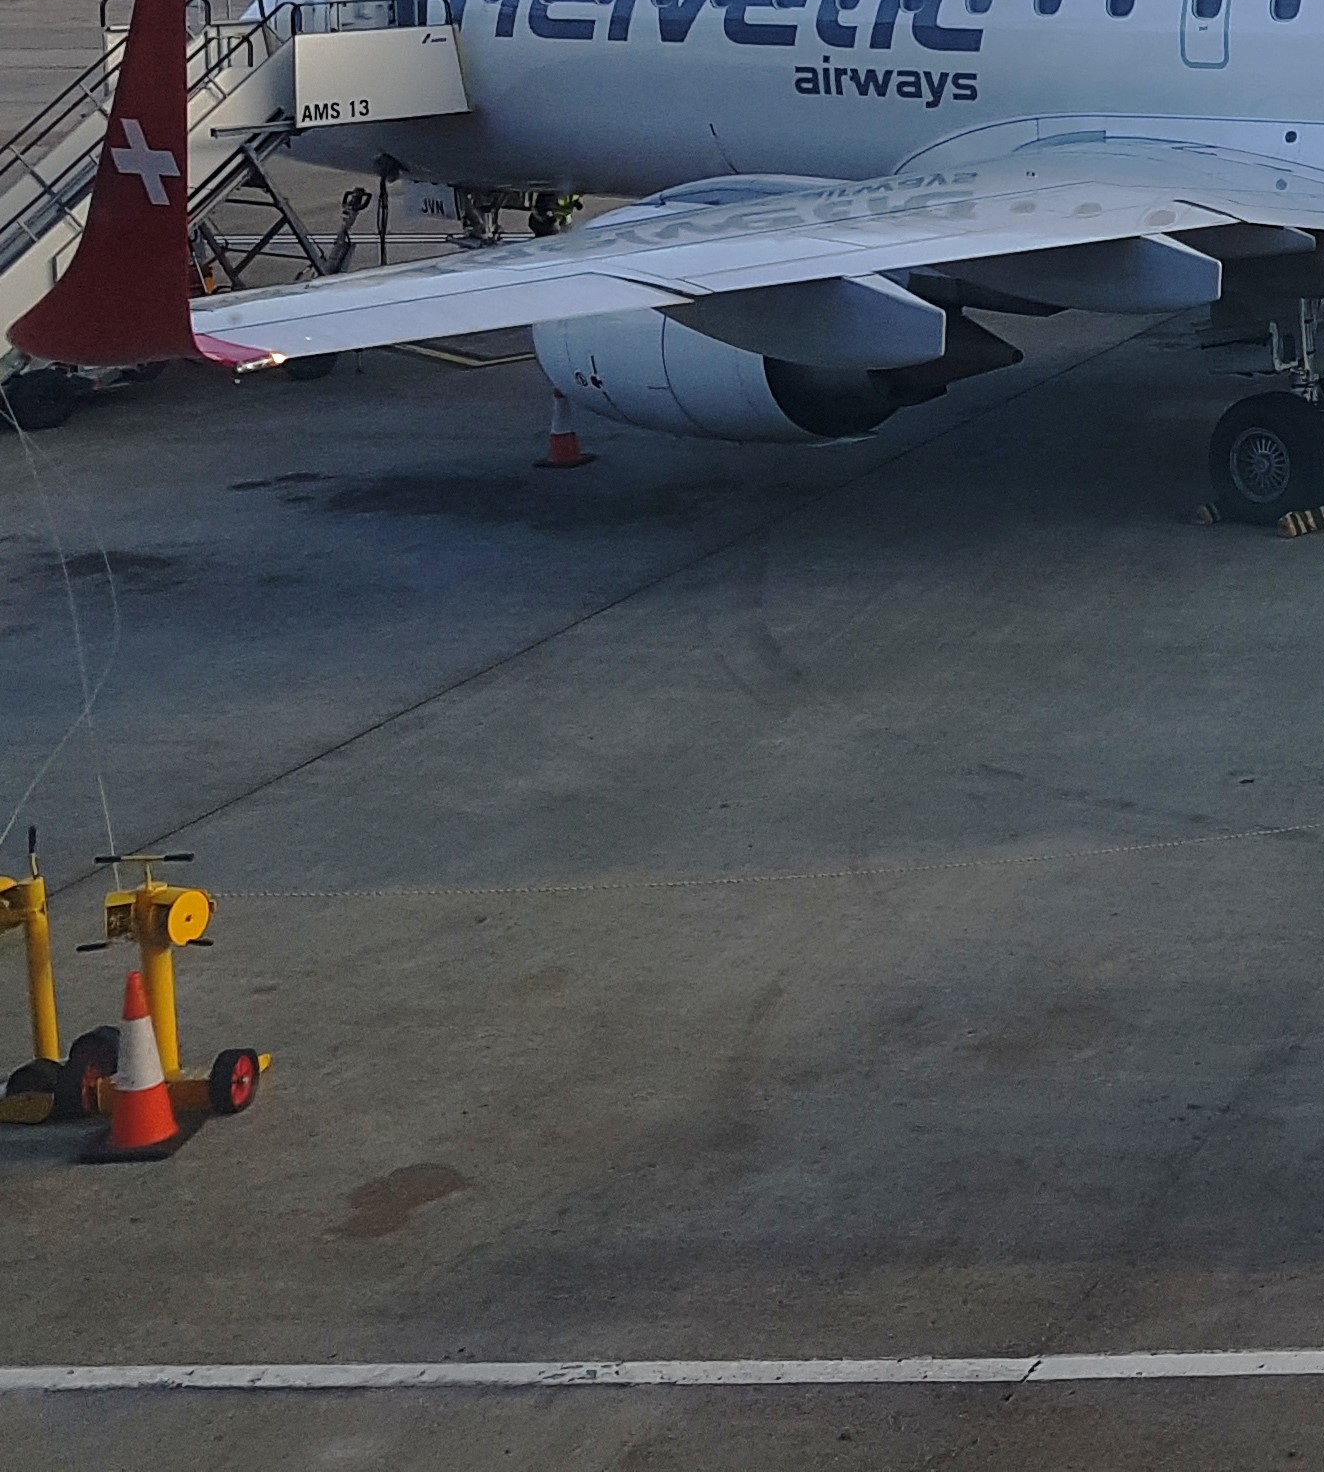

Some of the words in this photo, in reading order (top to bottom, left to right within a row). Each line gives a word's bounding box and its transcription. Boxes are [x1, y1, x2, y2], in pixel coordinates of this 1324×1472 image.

[794, 55, 979, 108] airways
[302, 102, 341, 122] AMS
[349, 99, 370, 117] 13
[421, 197, 445, 215] JVN
